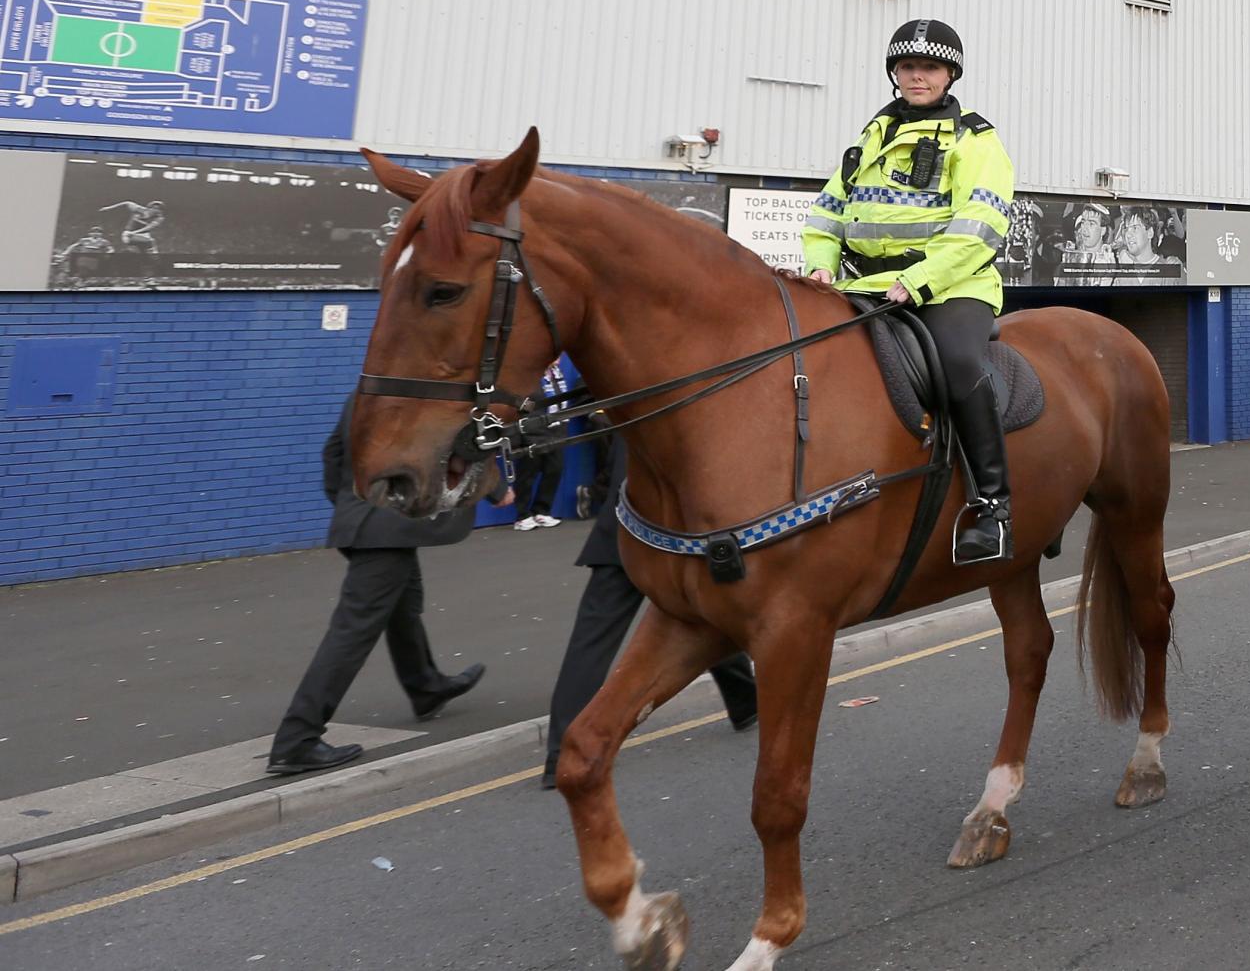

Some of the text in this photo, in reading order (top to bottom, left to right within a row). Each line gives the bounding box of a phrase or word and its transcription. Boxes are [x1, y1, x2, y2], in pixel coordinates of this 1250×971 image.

[893, 172, 909, 184] POLI
[745, 198, 812, 209] TOP BALCO
[744, 211, 793, 221] TICKETS
[752, 231, 788, 241] SEATS
[760, 254, 804, 264] RNSTIL
